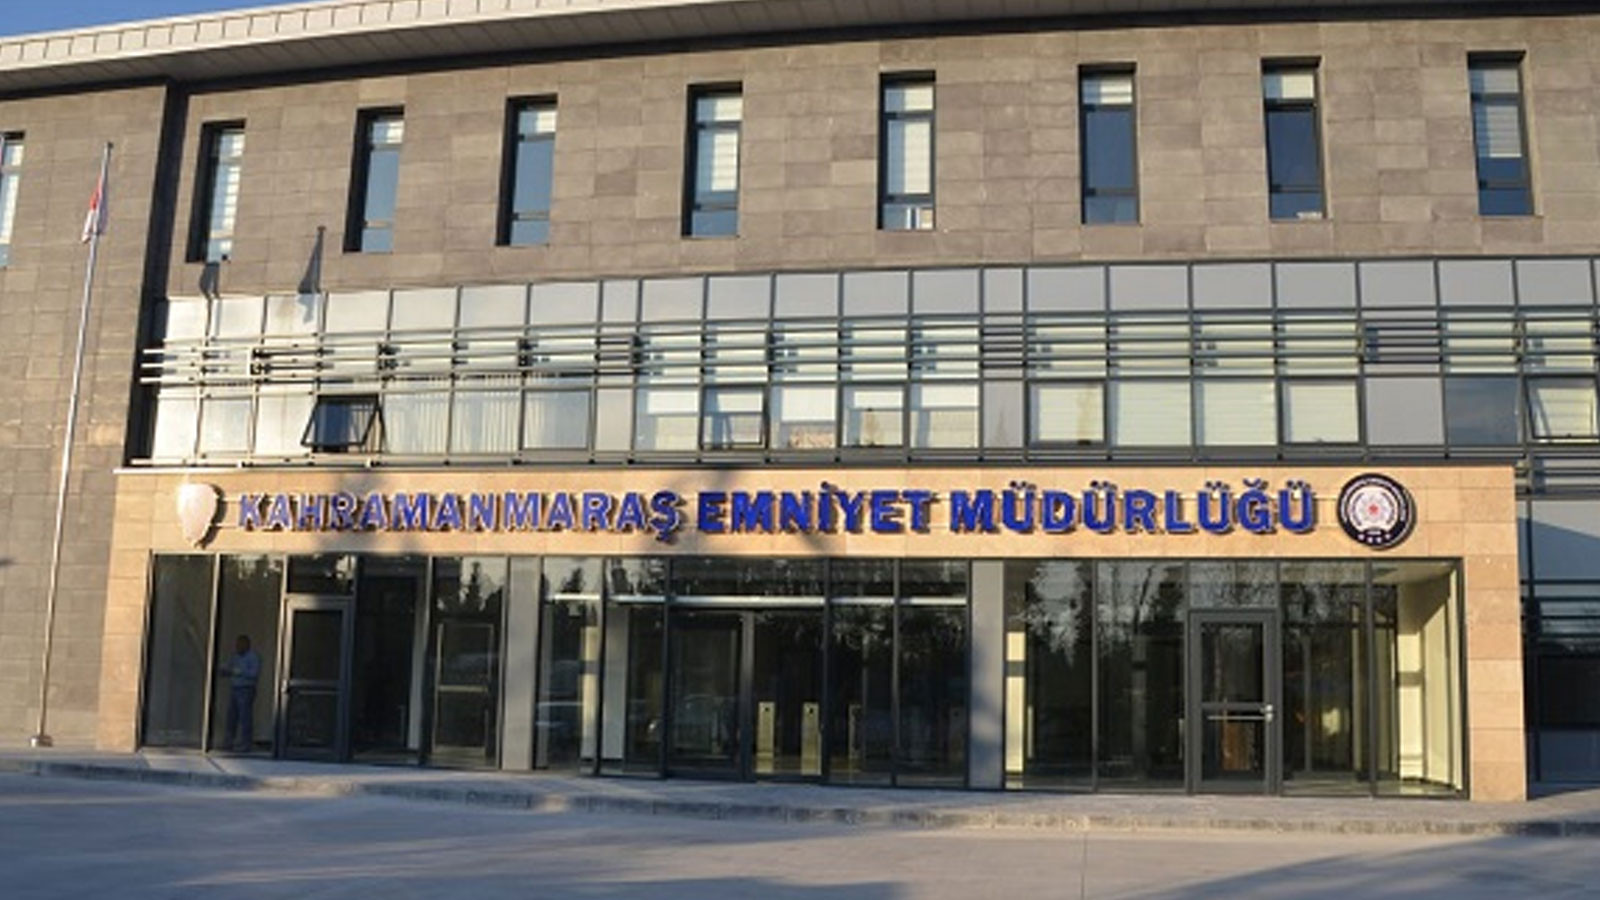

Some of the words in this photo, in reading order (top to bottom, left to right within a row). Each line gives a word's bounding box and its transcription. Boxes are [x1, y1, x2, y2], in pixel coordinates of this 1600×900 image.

[238, 490, 680, 541] KAHRAMANMARAŞ
[697, 481, 932, 533] EMNİYET
[951, 479, 1315, 533] MÜDÜRLÜĞÜ
